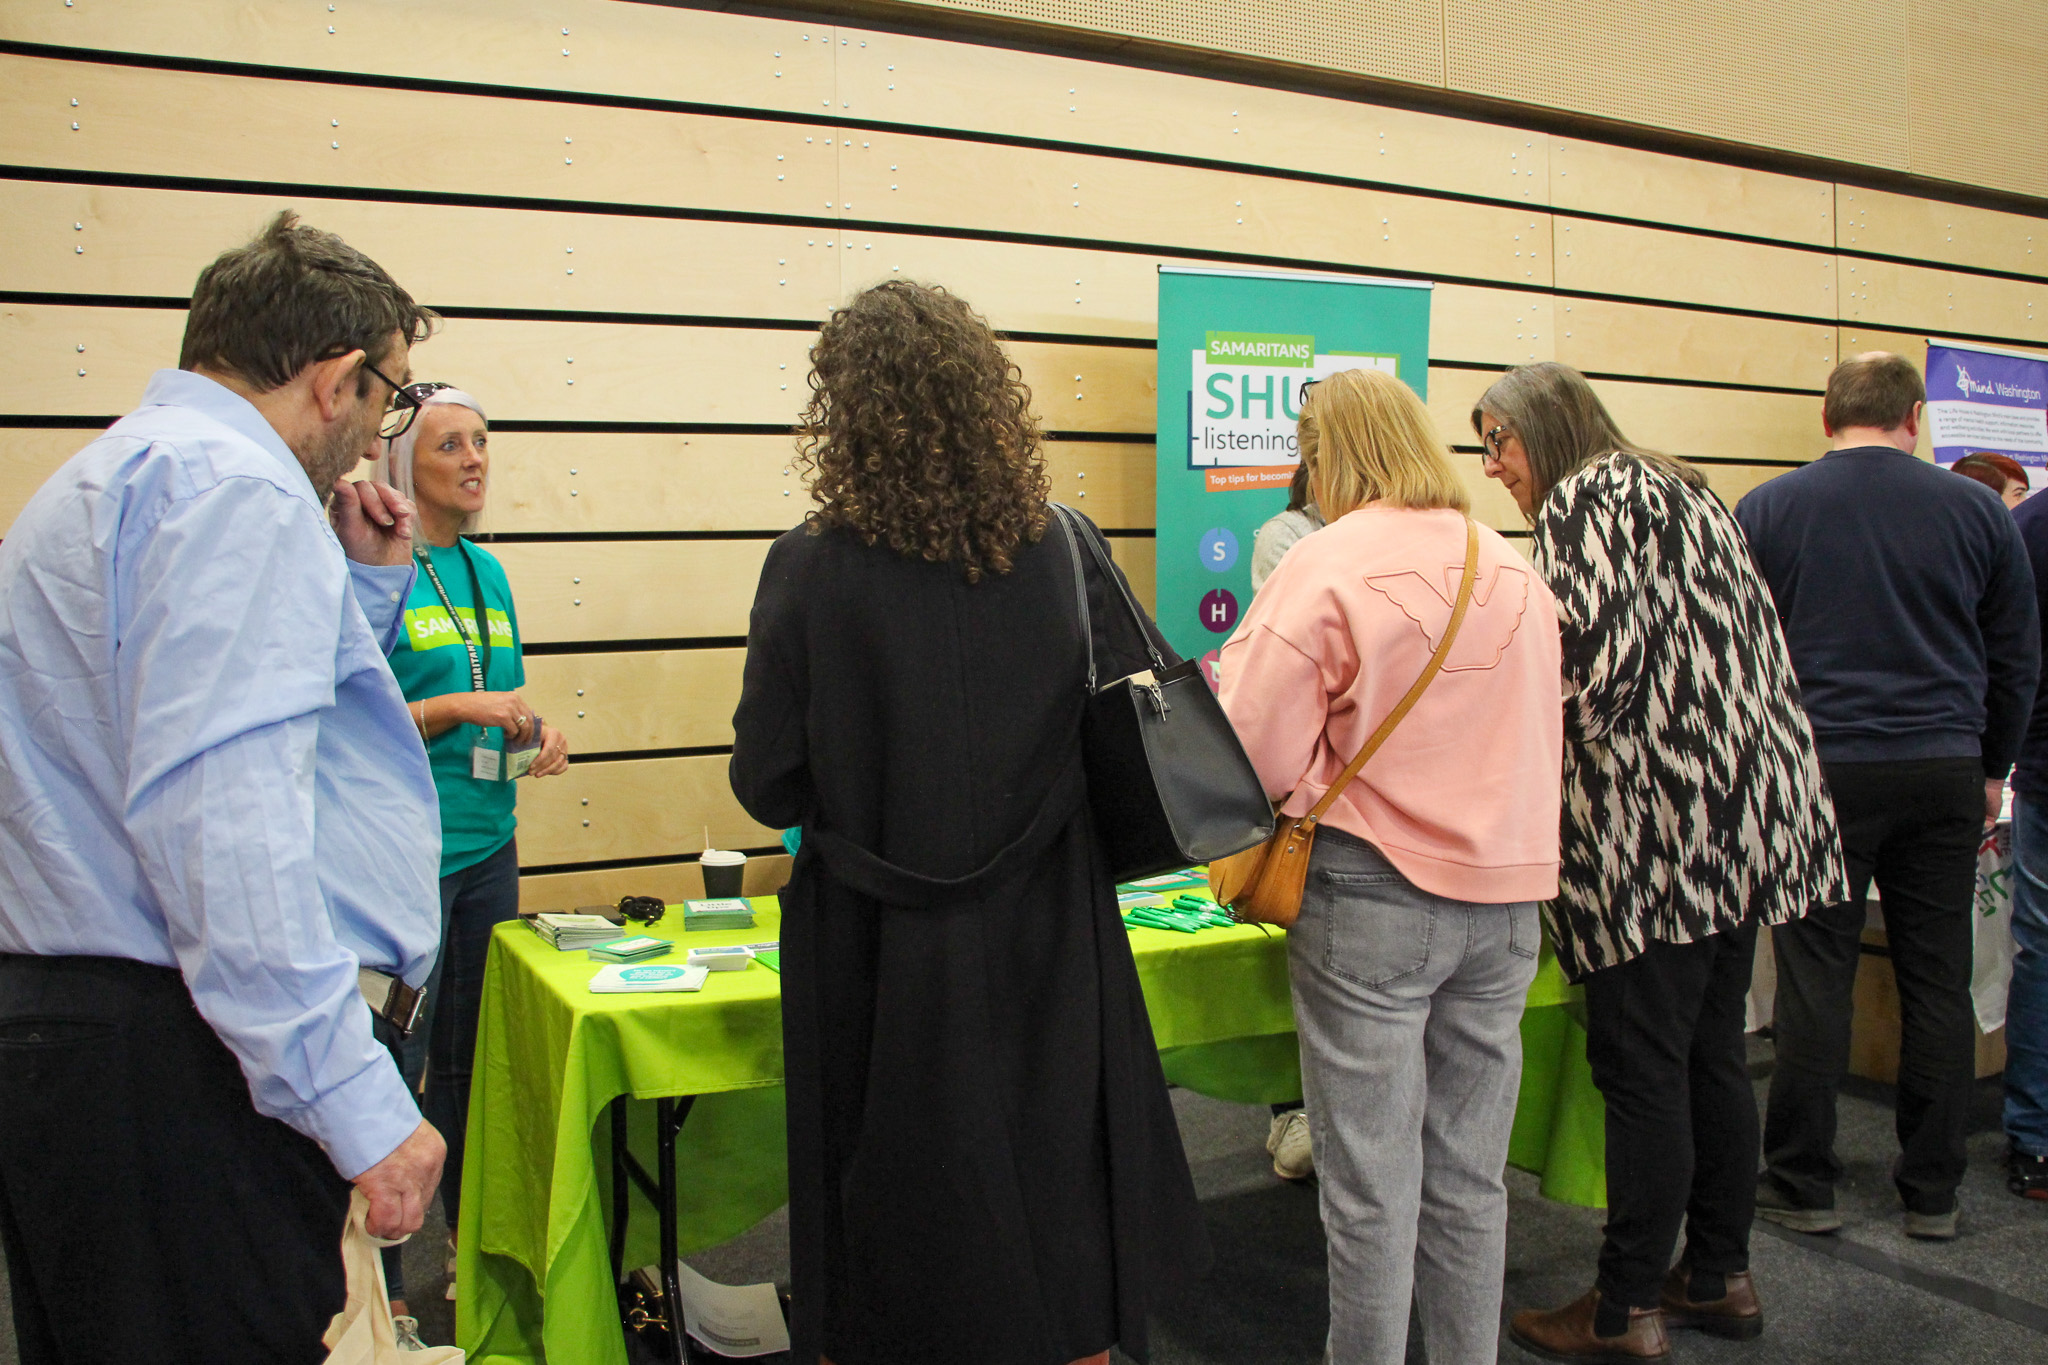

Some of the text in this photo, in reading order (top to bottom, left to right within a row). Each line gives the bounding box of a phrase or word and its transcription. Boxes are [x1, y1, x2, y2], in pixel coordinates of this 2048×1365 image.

[1210, 340, 1310, 359] SAMARITANS
[1995, 382, 2041, 403] Washington
[1204, 426, 1299, 457] listening
[1210, 475, 1227, 485] Top
[1228, 474, 1244, 485] tips
[1246, 472, 1258, 482] for
[1212, 541, 1226, 561] S
[426, 563, 466, 633] www.samaritans.org
[1211, 603, 1227, 622] H
[414, 617, 513, 638] SAMRIANS
